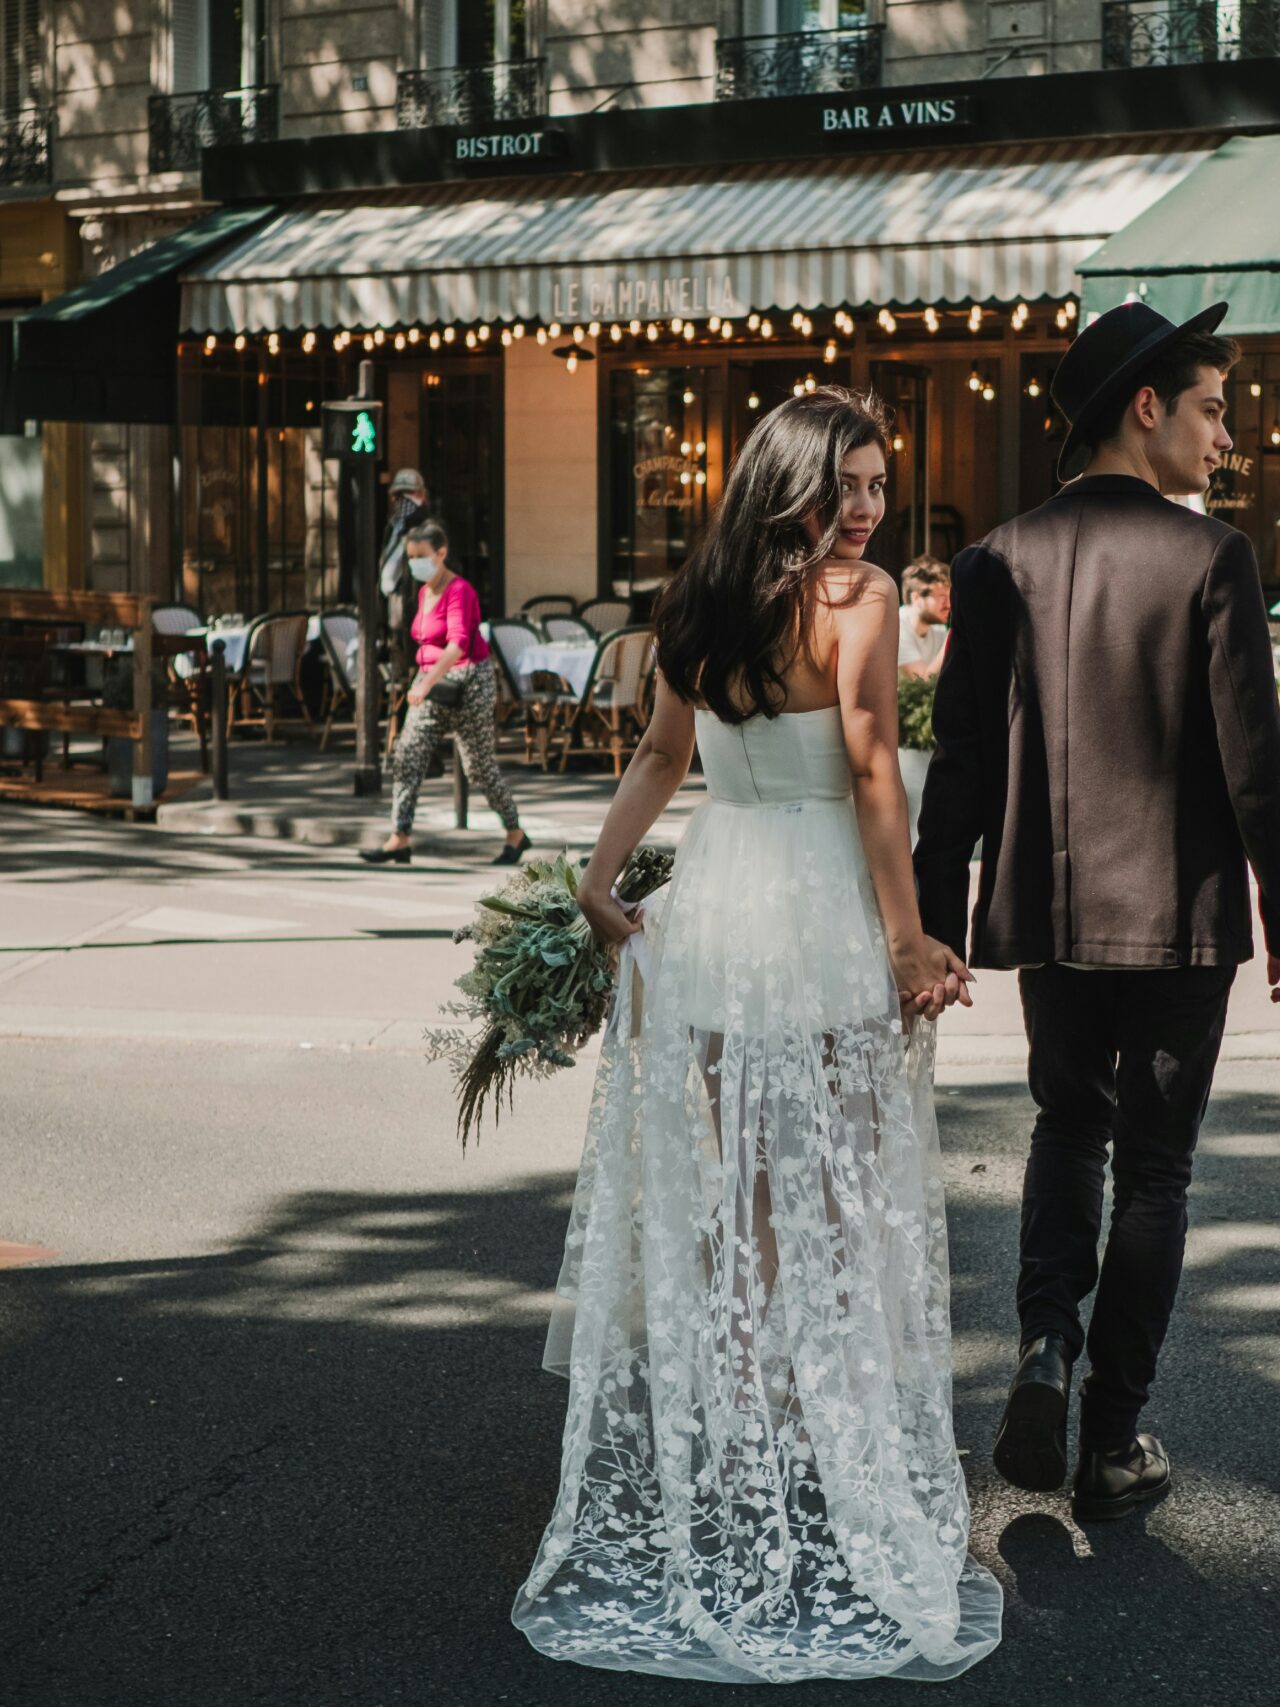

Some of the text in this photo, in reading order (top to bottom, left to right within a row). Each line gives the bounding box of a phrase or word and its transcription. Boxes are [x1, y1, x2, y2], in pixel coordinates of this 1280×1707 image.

[823, 99, 956, 131] BAR A VINS
[456, 132, 544, 159] BISTROT
[554, 275, 735, 318] LE CAMPANELLA
